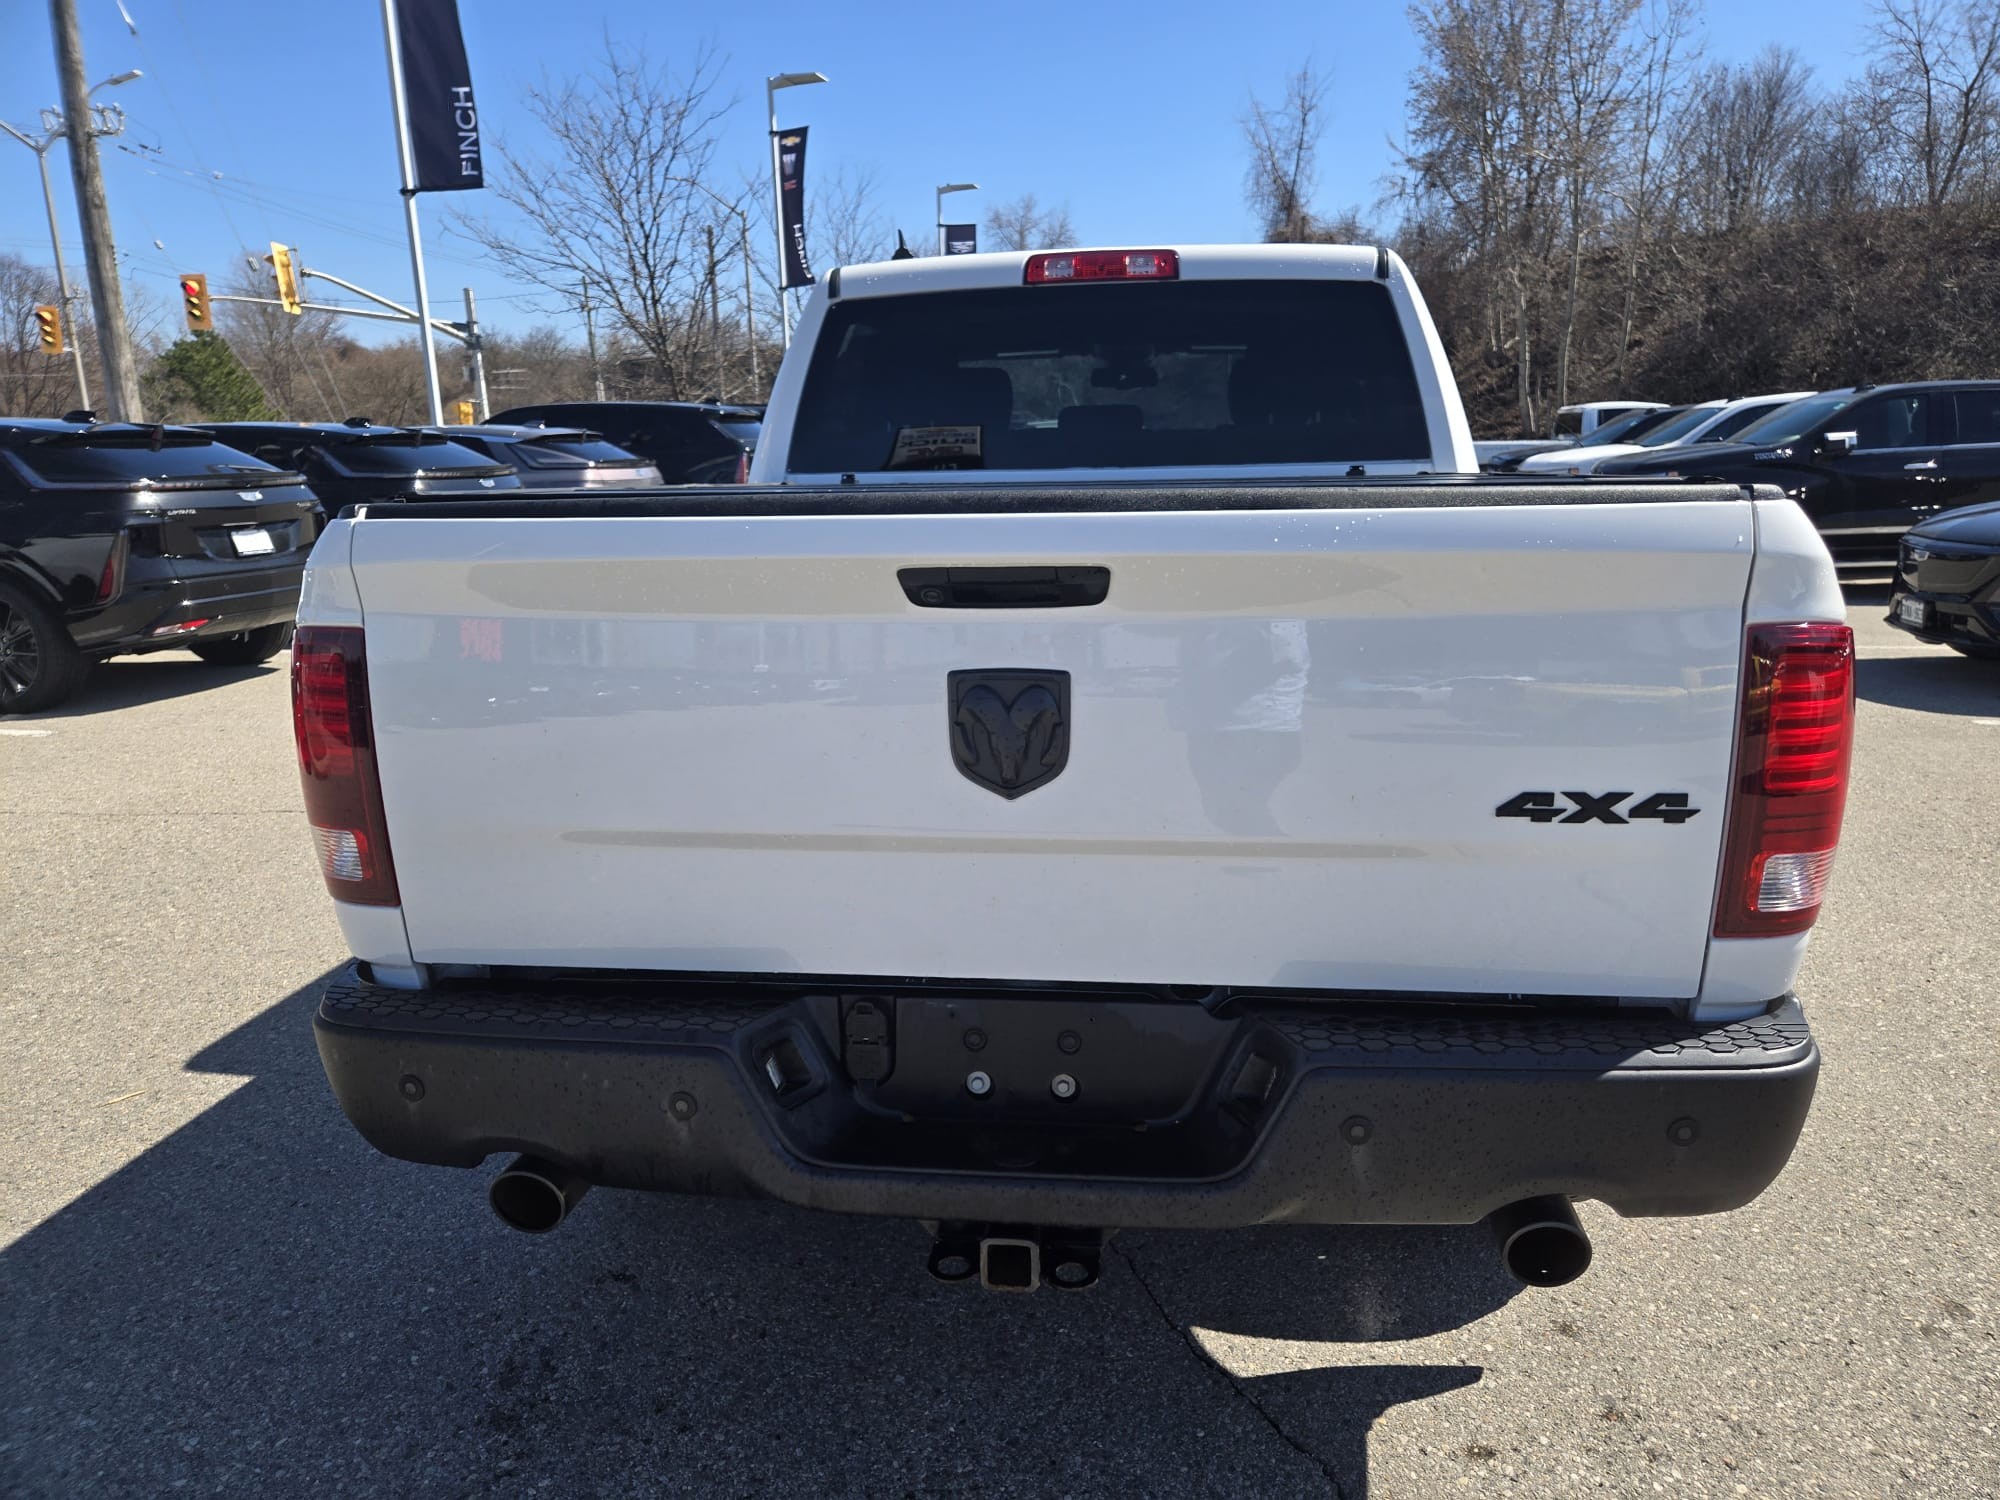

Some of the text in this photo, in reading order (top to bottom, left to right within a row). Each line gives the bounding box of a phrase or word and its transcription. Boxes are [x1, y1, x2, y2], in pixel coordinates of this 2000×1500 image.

[451, 86, 479, 176] FINCH
[793, 223, 812, 279] FINCH
[1495, 791, 1702, 825] 4X4
